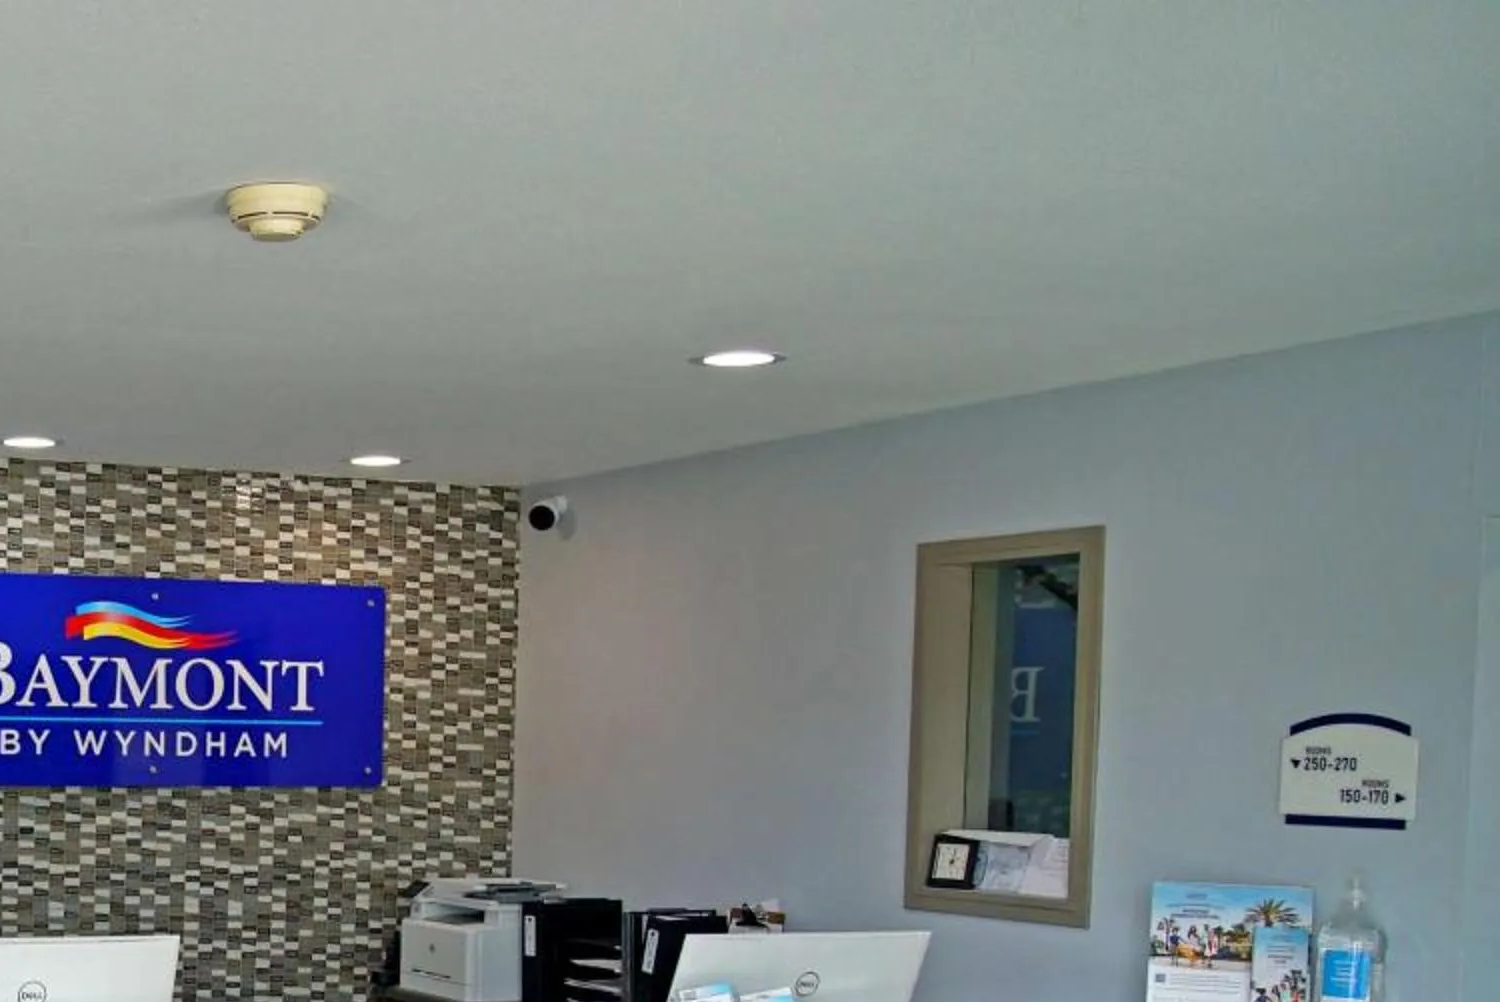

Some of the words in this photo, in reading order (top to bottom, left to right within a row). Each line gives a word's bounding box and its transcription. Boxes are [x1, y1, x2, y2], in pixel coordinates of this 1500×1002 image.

[0, 729, 50, 755] BY
[73, 729, 287, 757] WYNDHAM
[1303, 757, 1358, 771] 250-270
[1340, 789, 1389, 804] 150-170
